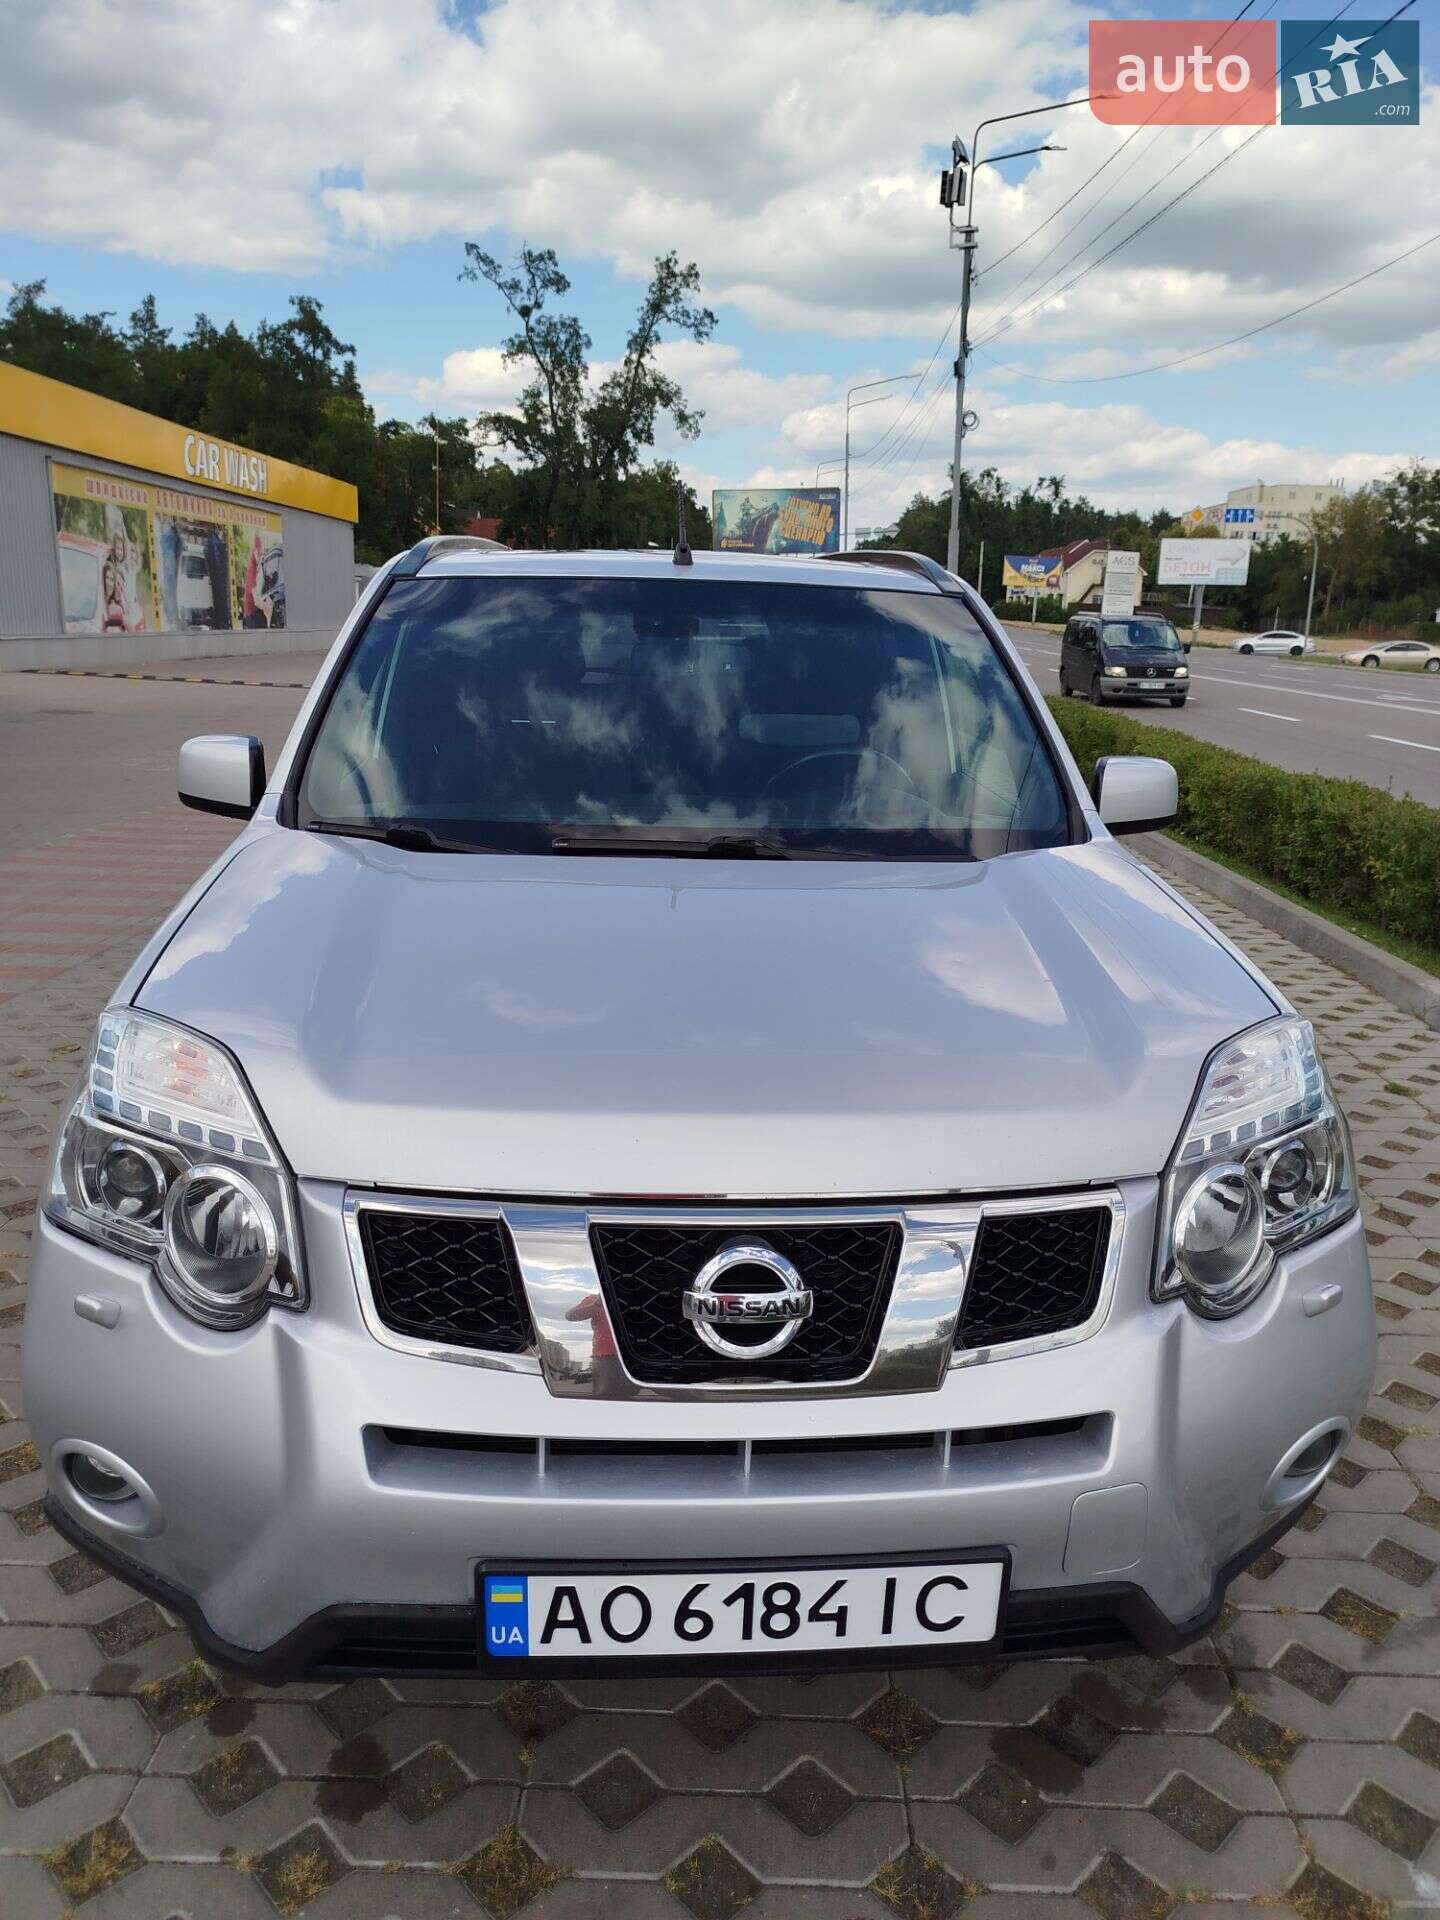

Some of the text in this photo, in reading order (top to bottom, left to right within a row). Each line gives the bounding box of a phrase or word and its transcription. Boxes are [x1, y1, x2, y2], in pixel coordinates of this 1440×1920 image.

[184, 434, 267, 494] CAR WASH
[697, 1297, 801, 1317] NISSAN
[540, 1575, 969, 1644] AO 6184 IC
[491, 1626, 524, 1644] UA
